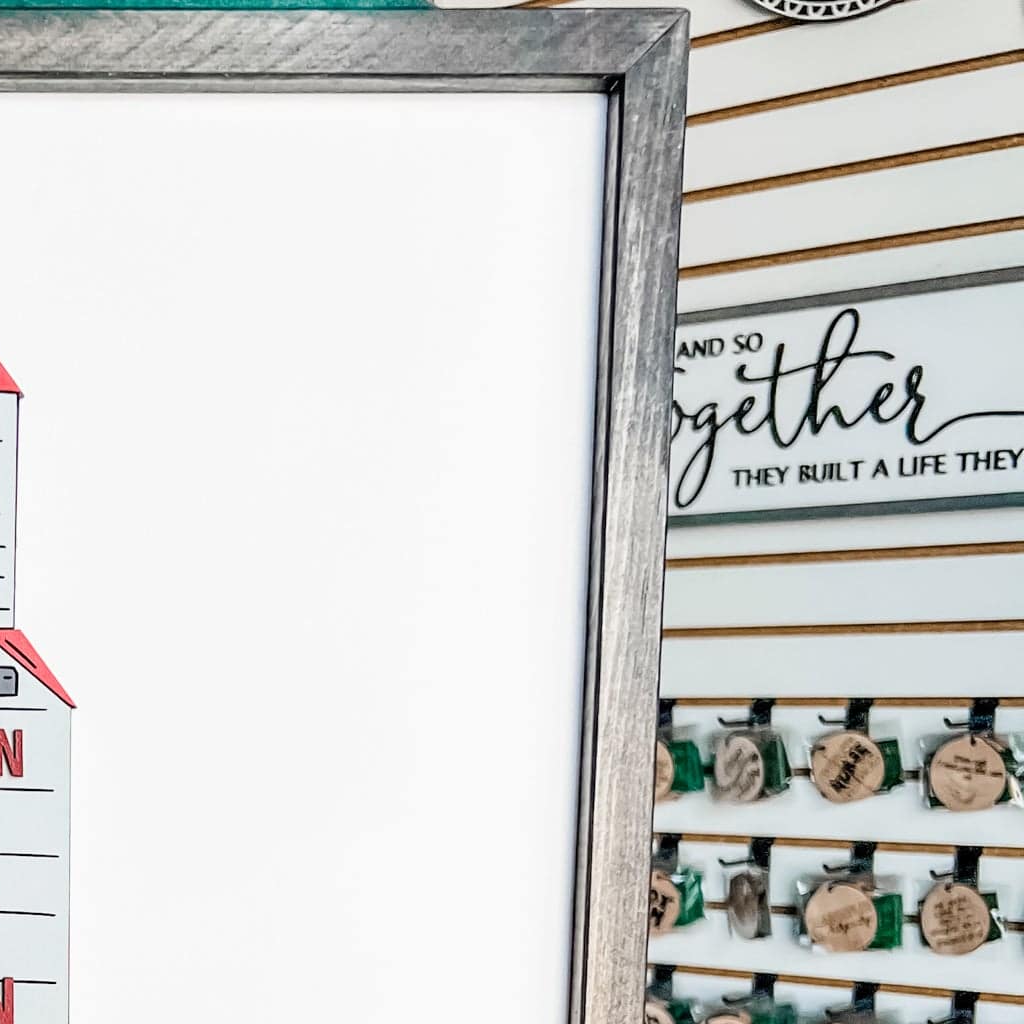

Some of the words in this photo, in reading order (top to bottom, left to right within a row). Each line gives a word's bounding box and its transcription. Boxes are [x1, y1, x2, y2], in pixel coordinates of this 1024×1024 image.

[676, 338, 725, 359] AND
[733, 332, 763, 354] SO
[731, 466, 789, 488] THEY
[798, 460, 865, 483] BUILT
[871, 458, 890, 479] A
[898, 453, 948, 478] LIFE
[956, 448, 1024, 473] THEY
